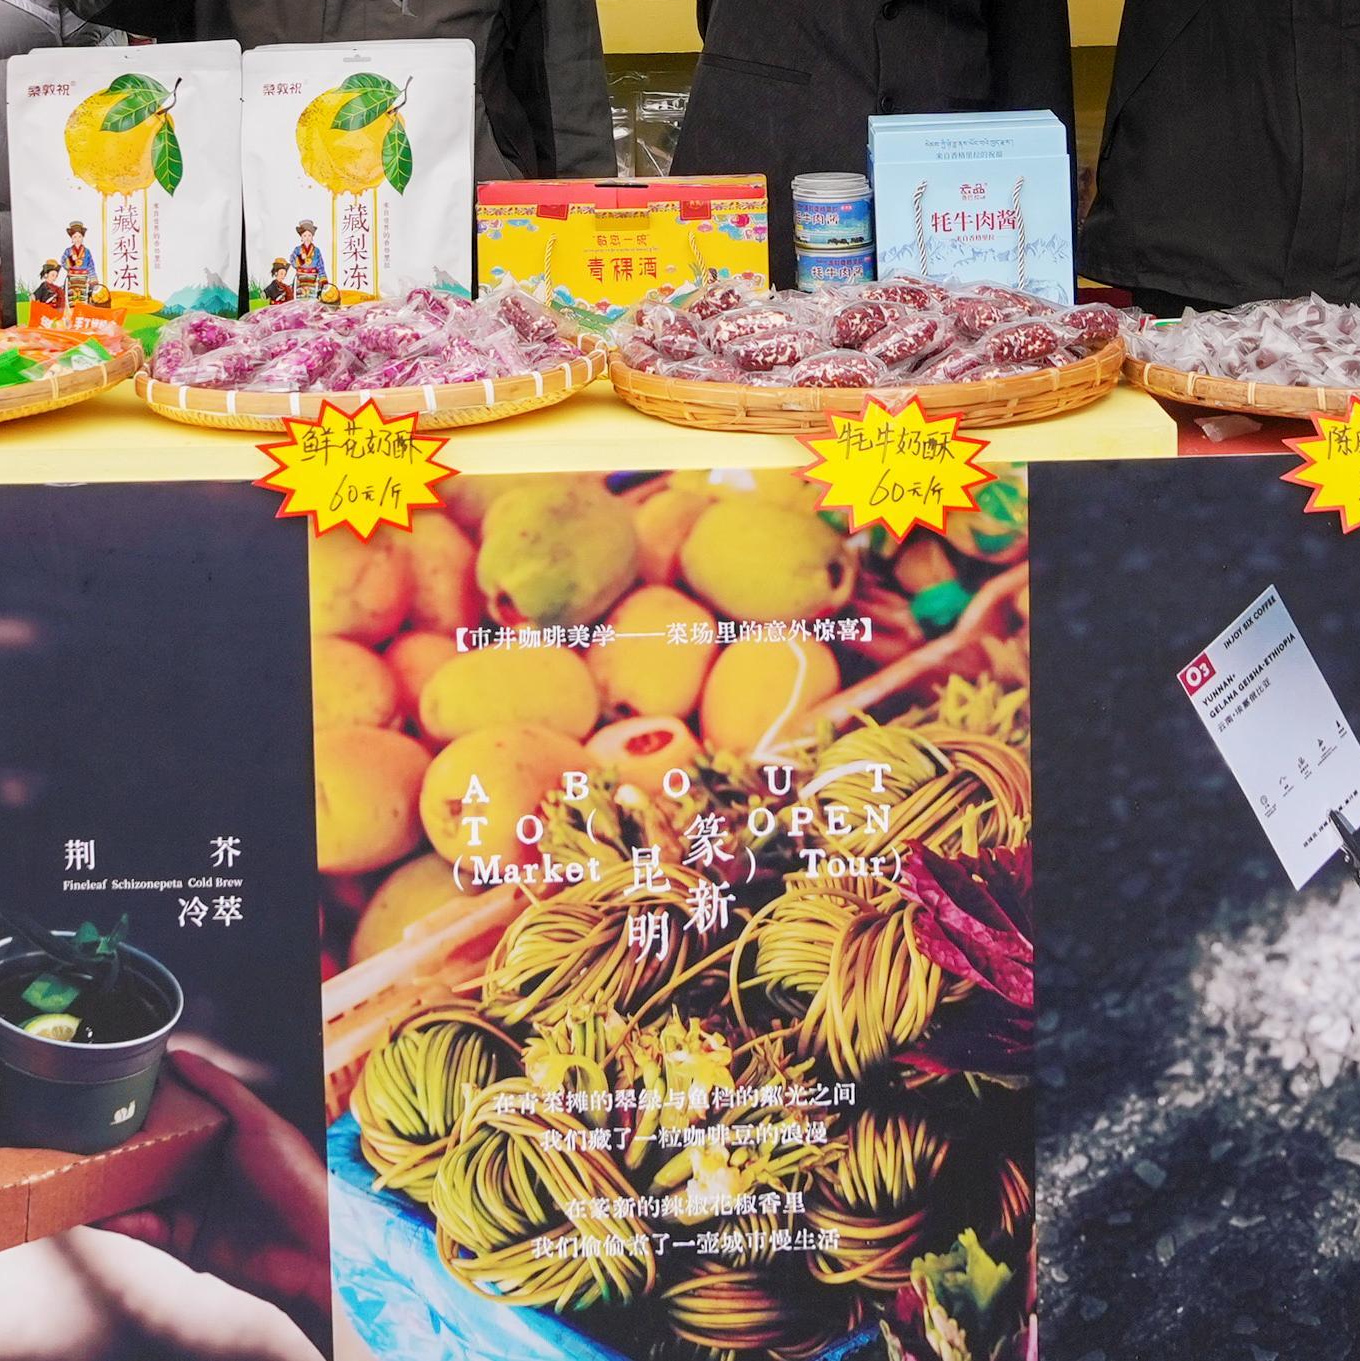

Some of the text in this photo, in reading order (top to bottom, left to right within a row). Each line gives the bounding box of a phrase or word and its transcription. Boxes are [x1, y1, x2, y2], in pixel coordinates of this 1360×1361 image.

[931, 210, 1017, 233] 牦牛肉酱
[111, 204, 141, 291] 藏梨冻
[341, 203, 370, 290] 藏梨冻
[586, 256, 657, 284] 青稞酒
[746, 804, 892, 838] OPEN
[111, 878, 183, 891] Schizonepeta
[187, 877, 213, 888] Cold
[215, 878, 244, 888] Brew
[178, 895, 244, 927] 冷萃
